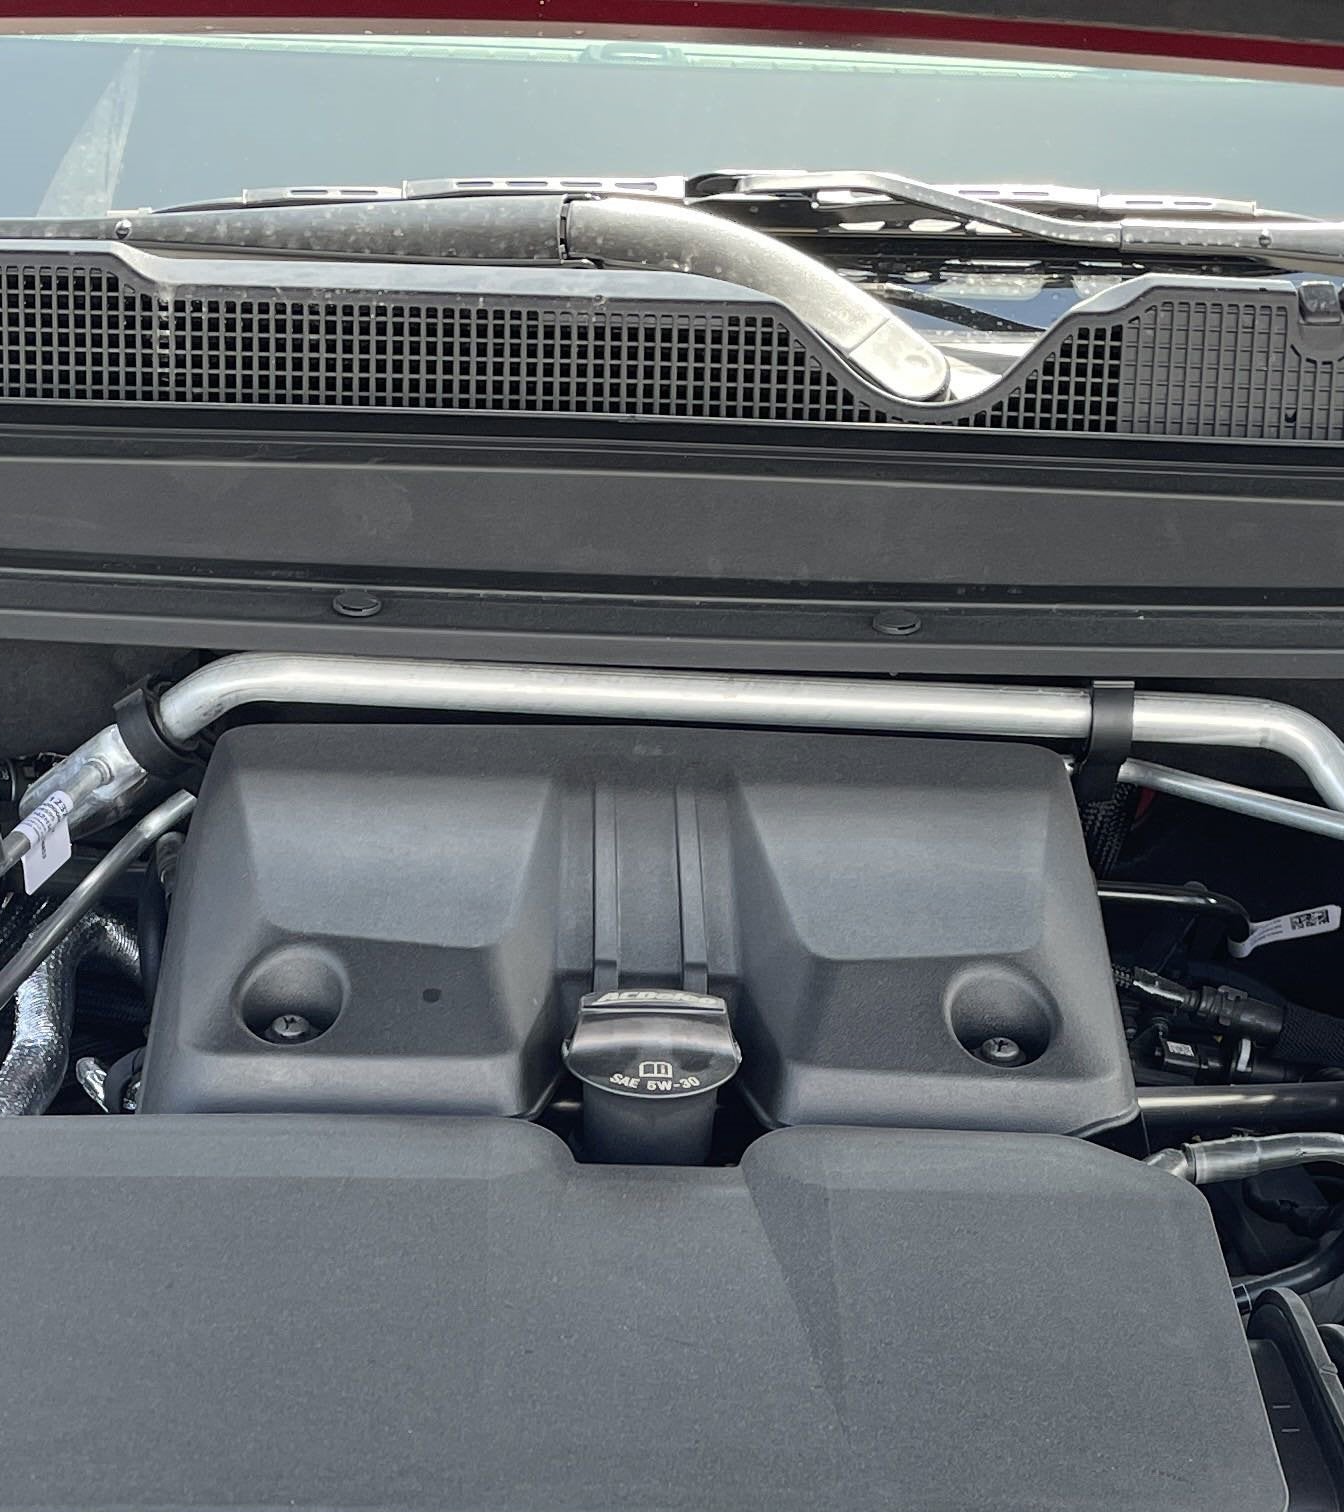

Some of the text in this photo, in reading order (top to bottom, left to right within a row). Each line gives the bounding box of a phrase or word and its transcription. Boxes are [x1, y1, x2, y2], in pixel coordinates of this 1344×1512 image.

[592, 991, 717, 1006] ACDelco
[609, 1073, 701, 1091] SAE 5W-30
